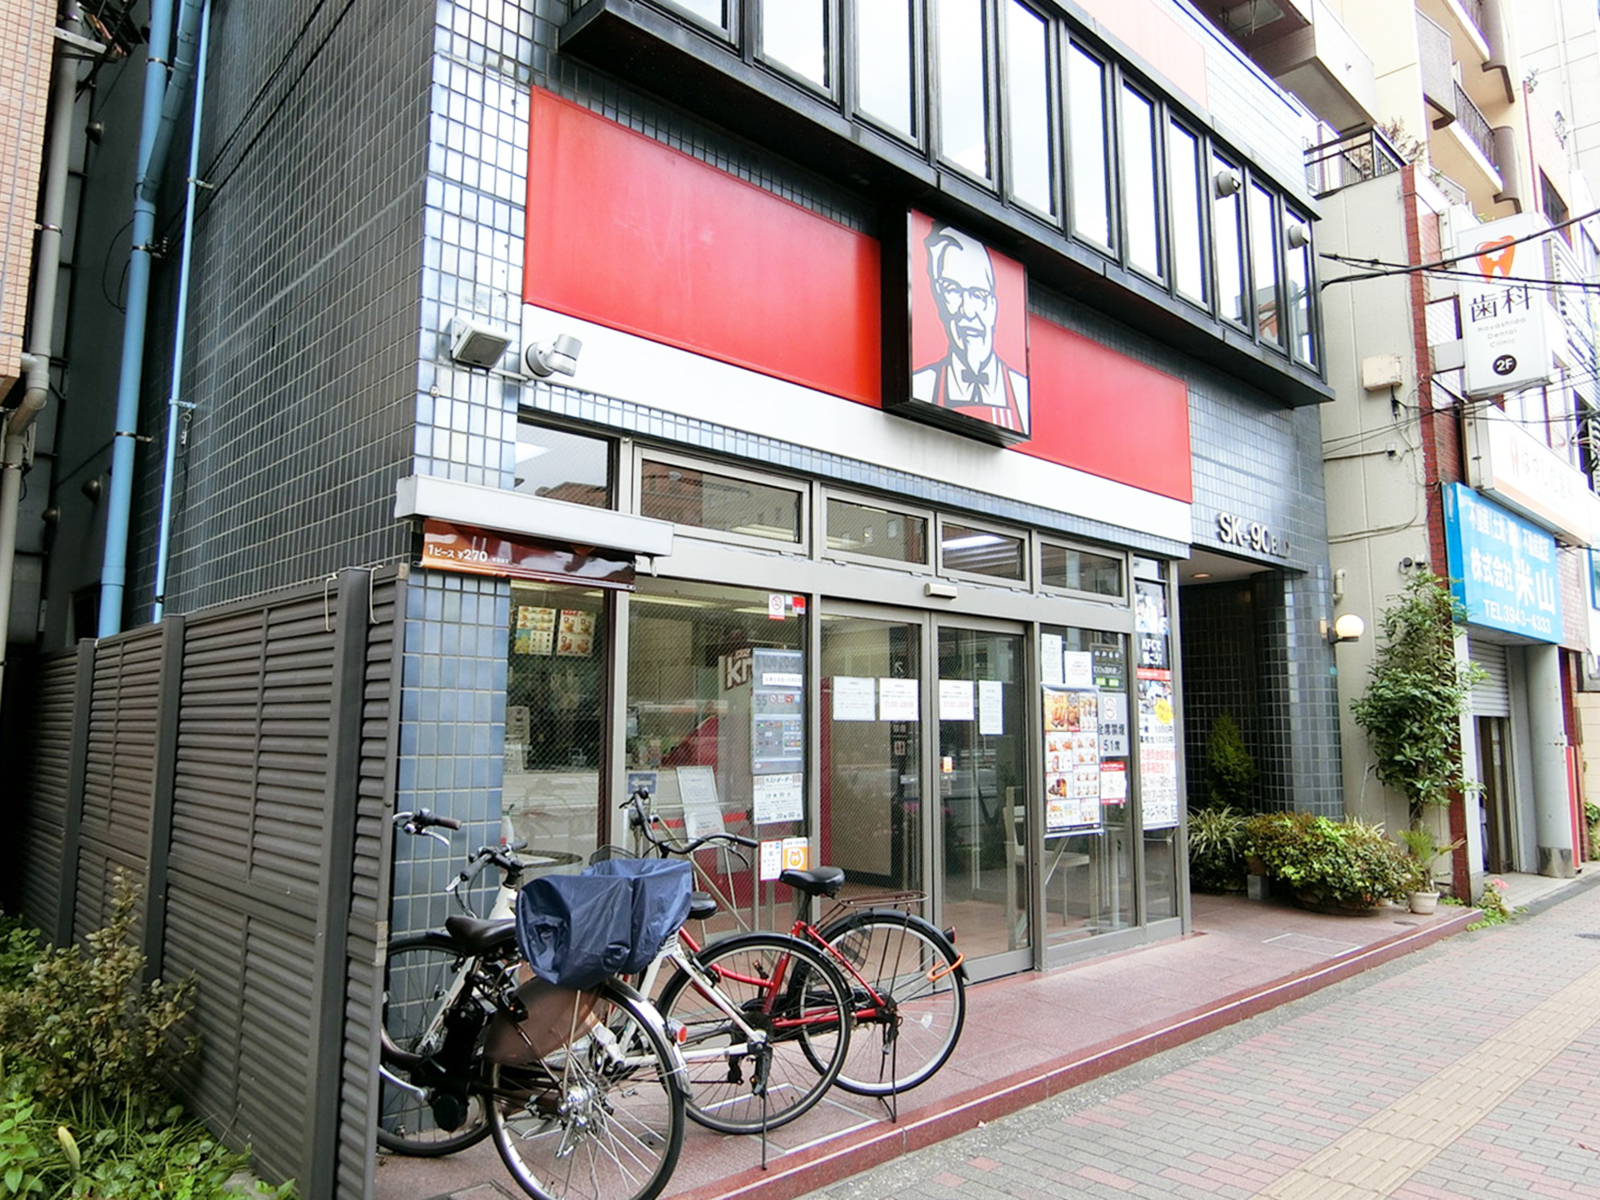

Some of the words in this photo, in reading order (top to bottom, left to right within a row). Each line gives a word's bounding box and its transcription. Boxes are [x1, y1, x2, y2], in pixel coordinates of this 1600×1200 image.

[1469, 283, 1533, 322] 歯科
[1477, 318, 1526, 333] Hayashida
[1487, 328, 1517, 340] Dental
[1490, 338, 1516, 348] Clinic
[1496, 357, 1513, 372] 2F
[457, 548, 488, 563] ¥270
